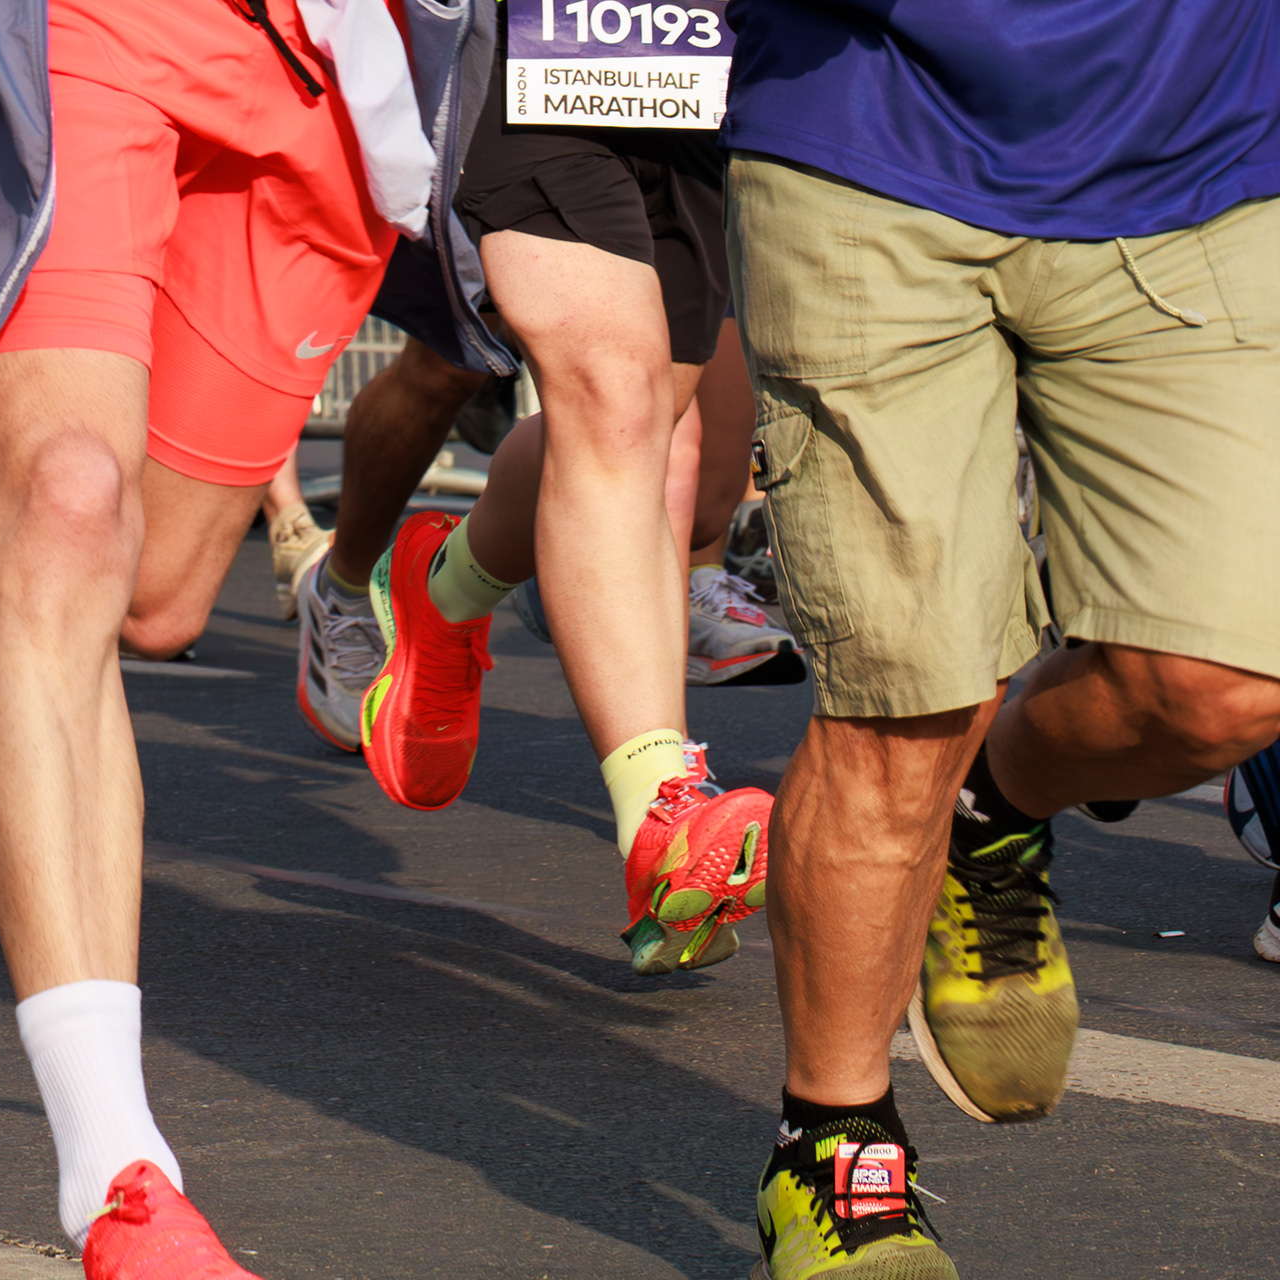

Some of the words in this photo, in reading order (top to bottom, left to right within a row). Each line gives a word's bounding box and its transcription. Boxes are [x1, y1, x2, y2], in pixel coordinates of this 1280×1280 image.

[566, 0, 722, 49] 10193
[544, 68, 643, 88] ISTANBUL
[647, 72, 700, 89] HALF
[544, 94, 701, 119] MARATHON
[627, 739, 679, 760] KIPRUN
[852, 1184, 890, 1193] TIMING
